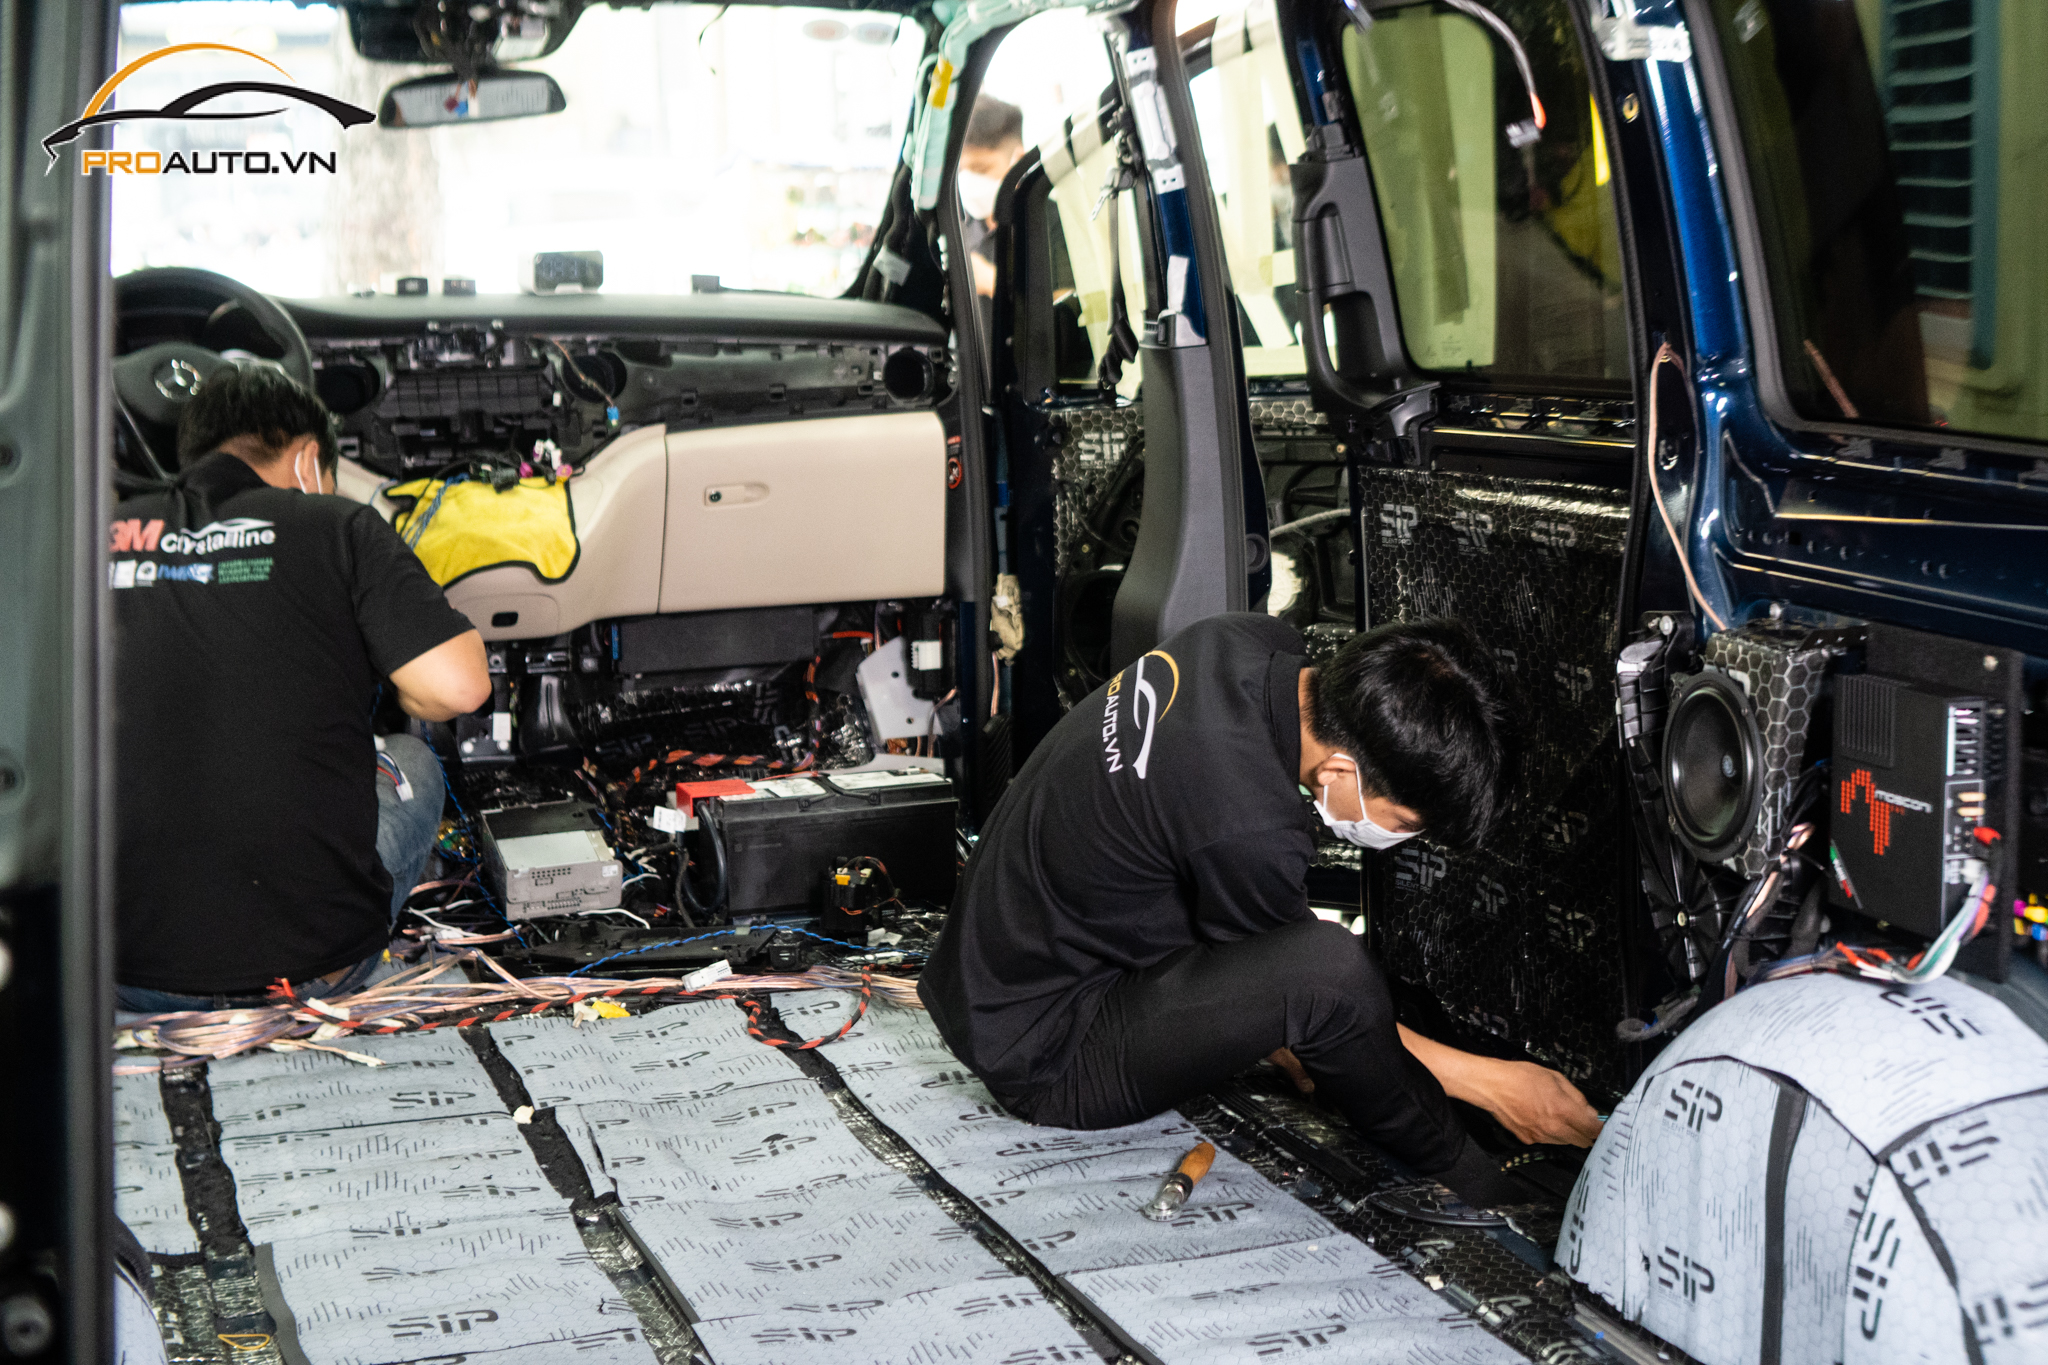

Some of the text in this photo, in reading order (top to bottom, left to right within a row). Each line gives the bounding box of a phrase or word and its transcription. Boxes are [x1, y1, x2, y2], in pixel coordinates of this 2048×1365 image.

[1102, 669, 1125, 773] ROAUTO.VN
[1664, 1079, 1723, 1132] SIP
[1658, 1246, 1715, 1303] SIP
[387, 1309, 499, 1338] SIP
[1246, 1324, 1347, 1356] SIP
